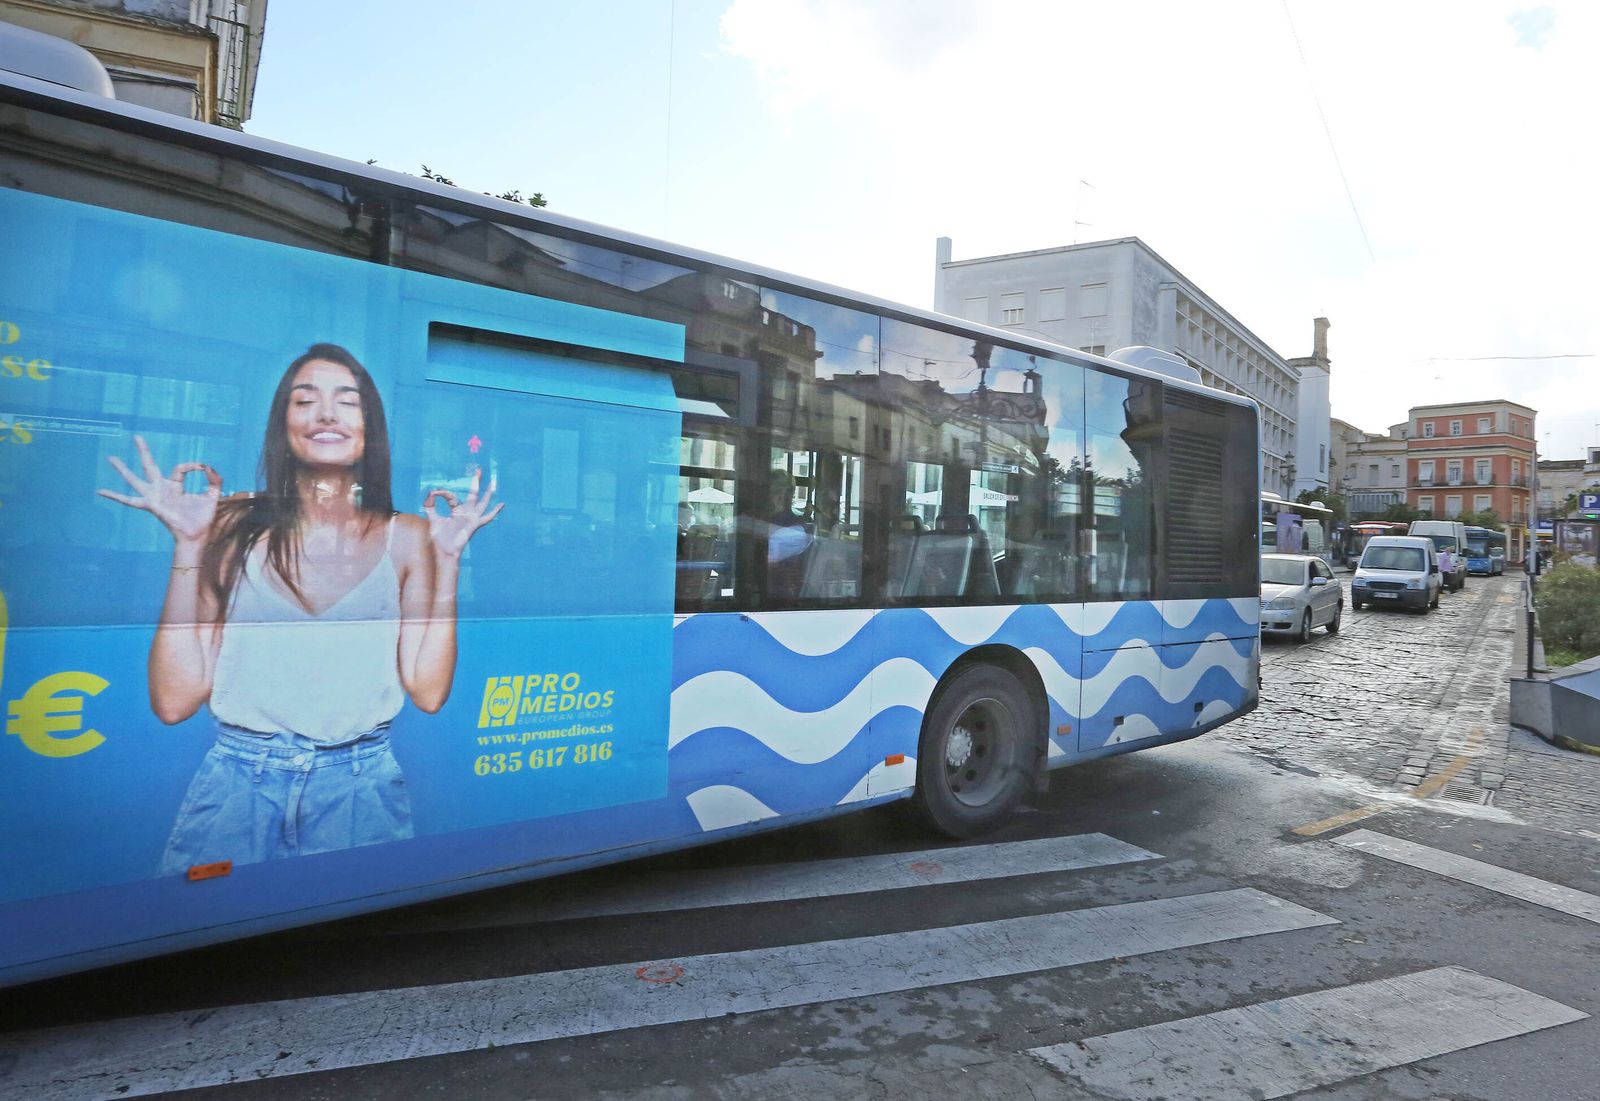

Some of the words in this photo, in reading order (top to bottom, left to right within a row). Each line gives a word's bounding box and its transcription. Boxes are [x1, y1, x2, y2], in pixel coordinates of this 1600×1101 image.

[1583, 495, 1598, 508] P
[524, 672, 580, 695] PRO
[520, 690, 615, 715] MEDIOS
[518, 713, 573, 725] EUROPEAN
[578, 709, 612, 720] GROUP
[476, 723, 614, 745] www.promedios.es
[474, 751, 523, 776] 635
[529, 746, 569, 769] 617
[574, 741, 613, 764] 816
